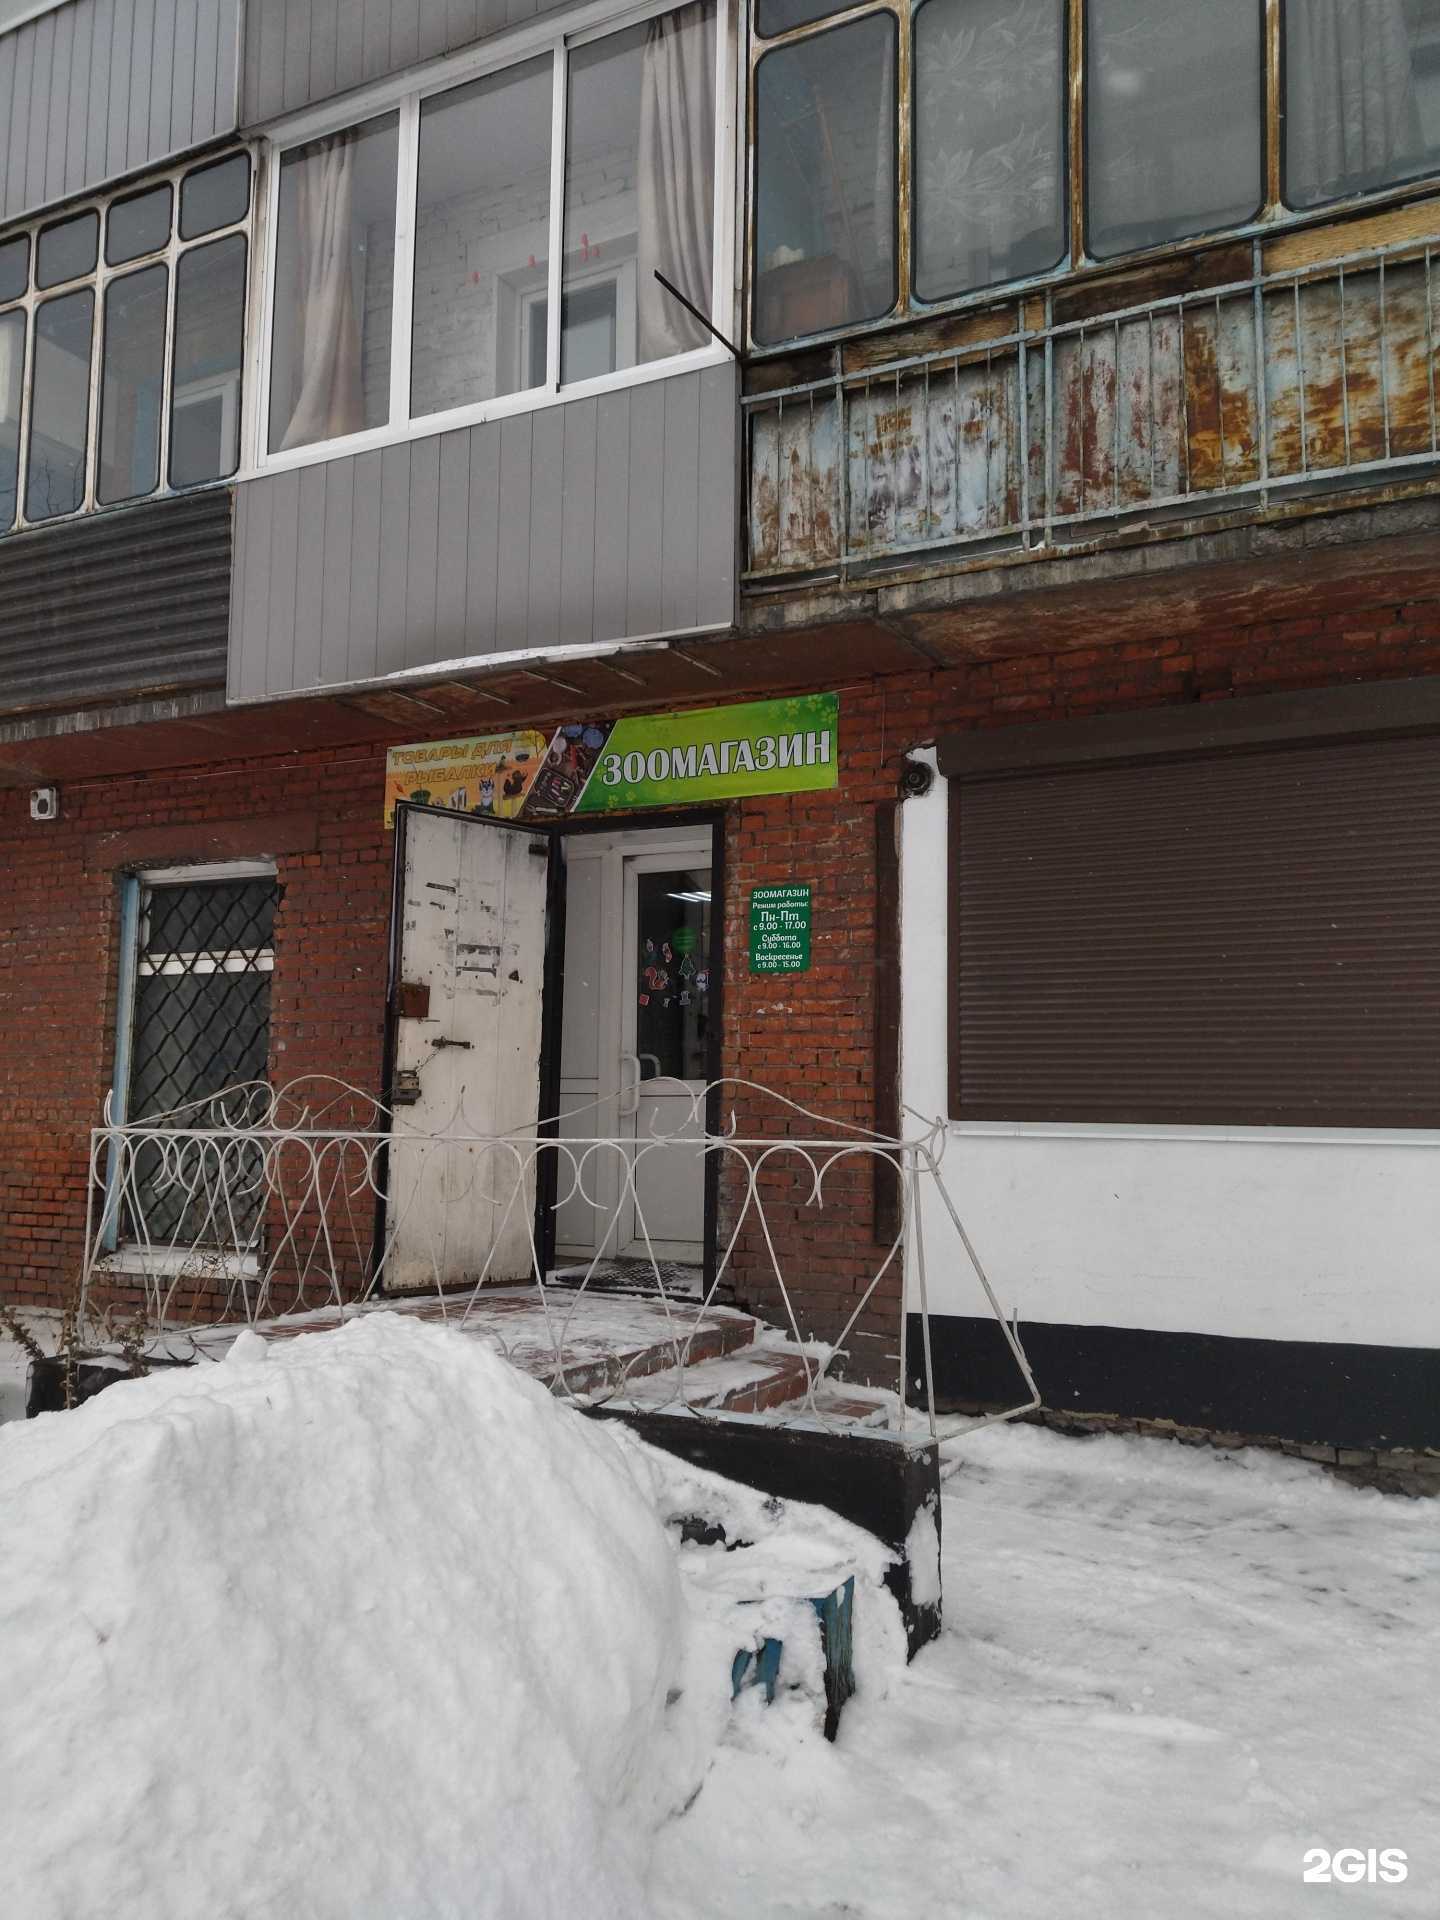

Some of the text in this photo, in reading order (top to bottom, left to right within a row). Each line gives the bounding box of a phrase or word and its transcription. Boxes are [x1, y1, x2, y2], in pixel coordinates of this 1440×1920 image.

[393, 739, 513, 766] ТОВАРЫ ДЛЯ
[602, 729, 831, 786] ЗООМАГАЗИН
[404, 762, 497, 785] РЫБАЛКИ
[753, 888, 809, 899] ЗООМАГАЗИН
[761, 910, 799, 922] Пн-Пт
[759, 922, 778, 931] 9.00
[785, 921, 807, 930] 17.00
[761, 933, 797, 943] Суббота
[783, 941, 801, 949] 16.00
[755, 953, 803, 962] Воскресенье
[783, 960, 801, 968] 15.00
